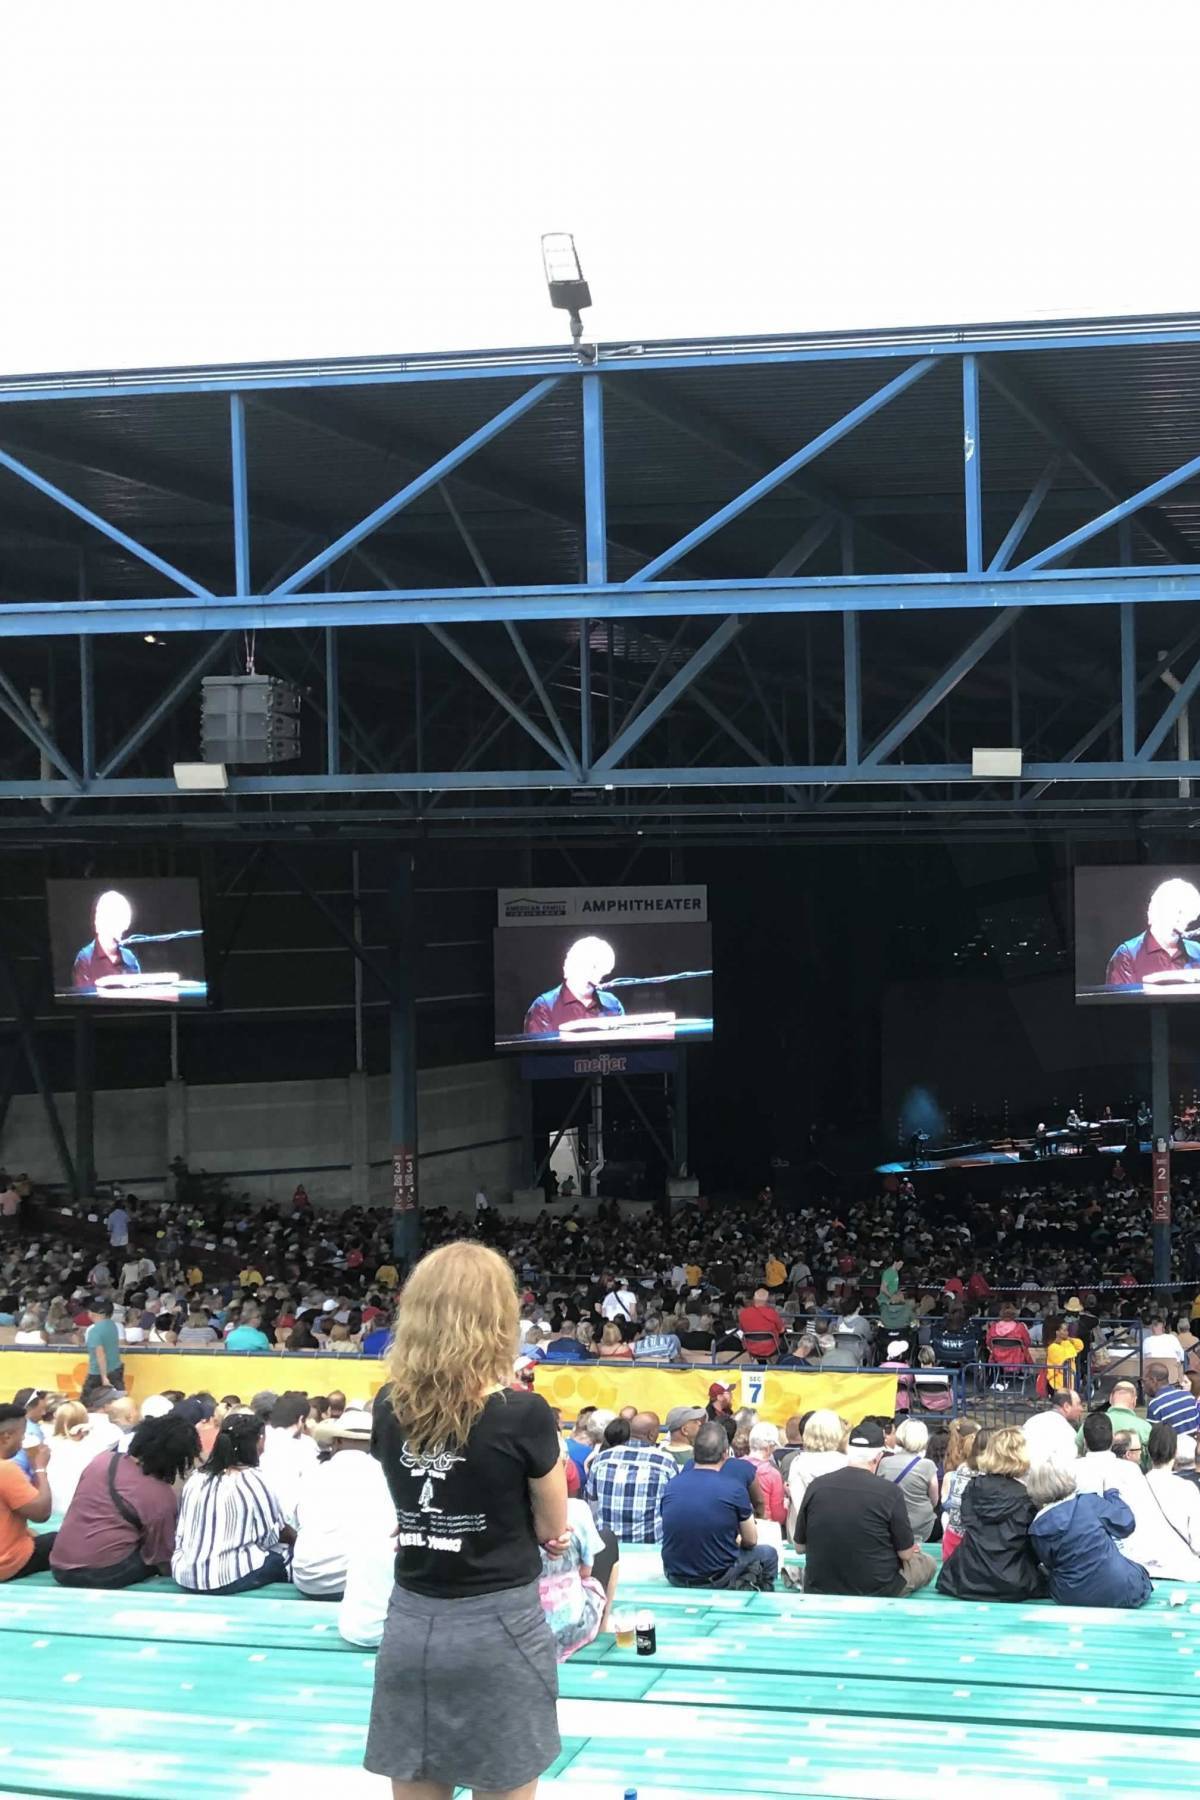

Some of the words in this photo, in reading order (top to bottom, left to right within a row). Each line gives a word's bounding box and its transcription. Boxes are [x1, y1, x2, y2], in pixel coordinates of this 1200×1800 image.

[582, 898, 702, 913] AMPHITHEATER
[574, 1054, 627, 1074] meijer
[394, 1161, 401, 1173] 3
[406, 1161, 413, 1173] 3
[1157, 1167, 1166, 1180] 2
[749, 1383, 762, 1403] 7
